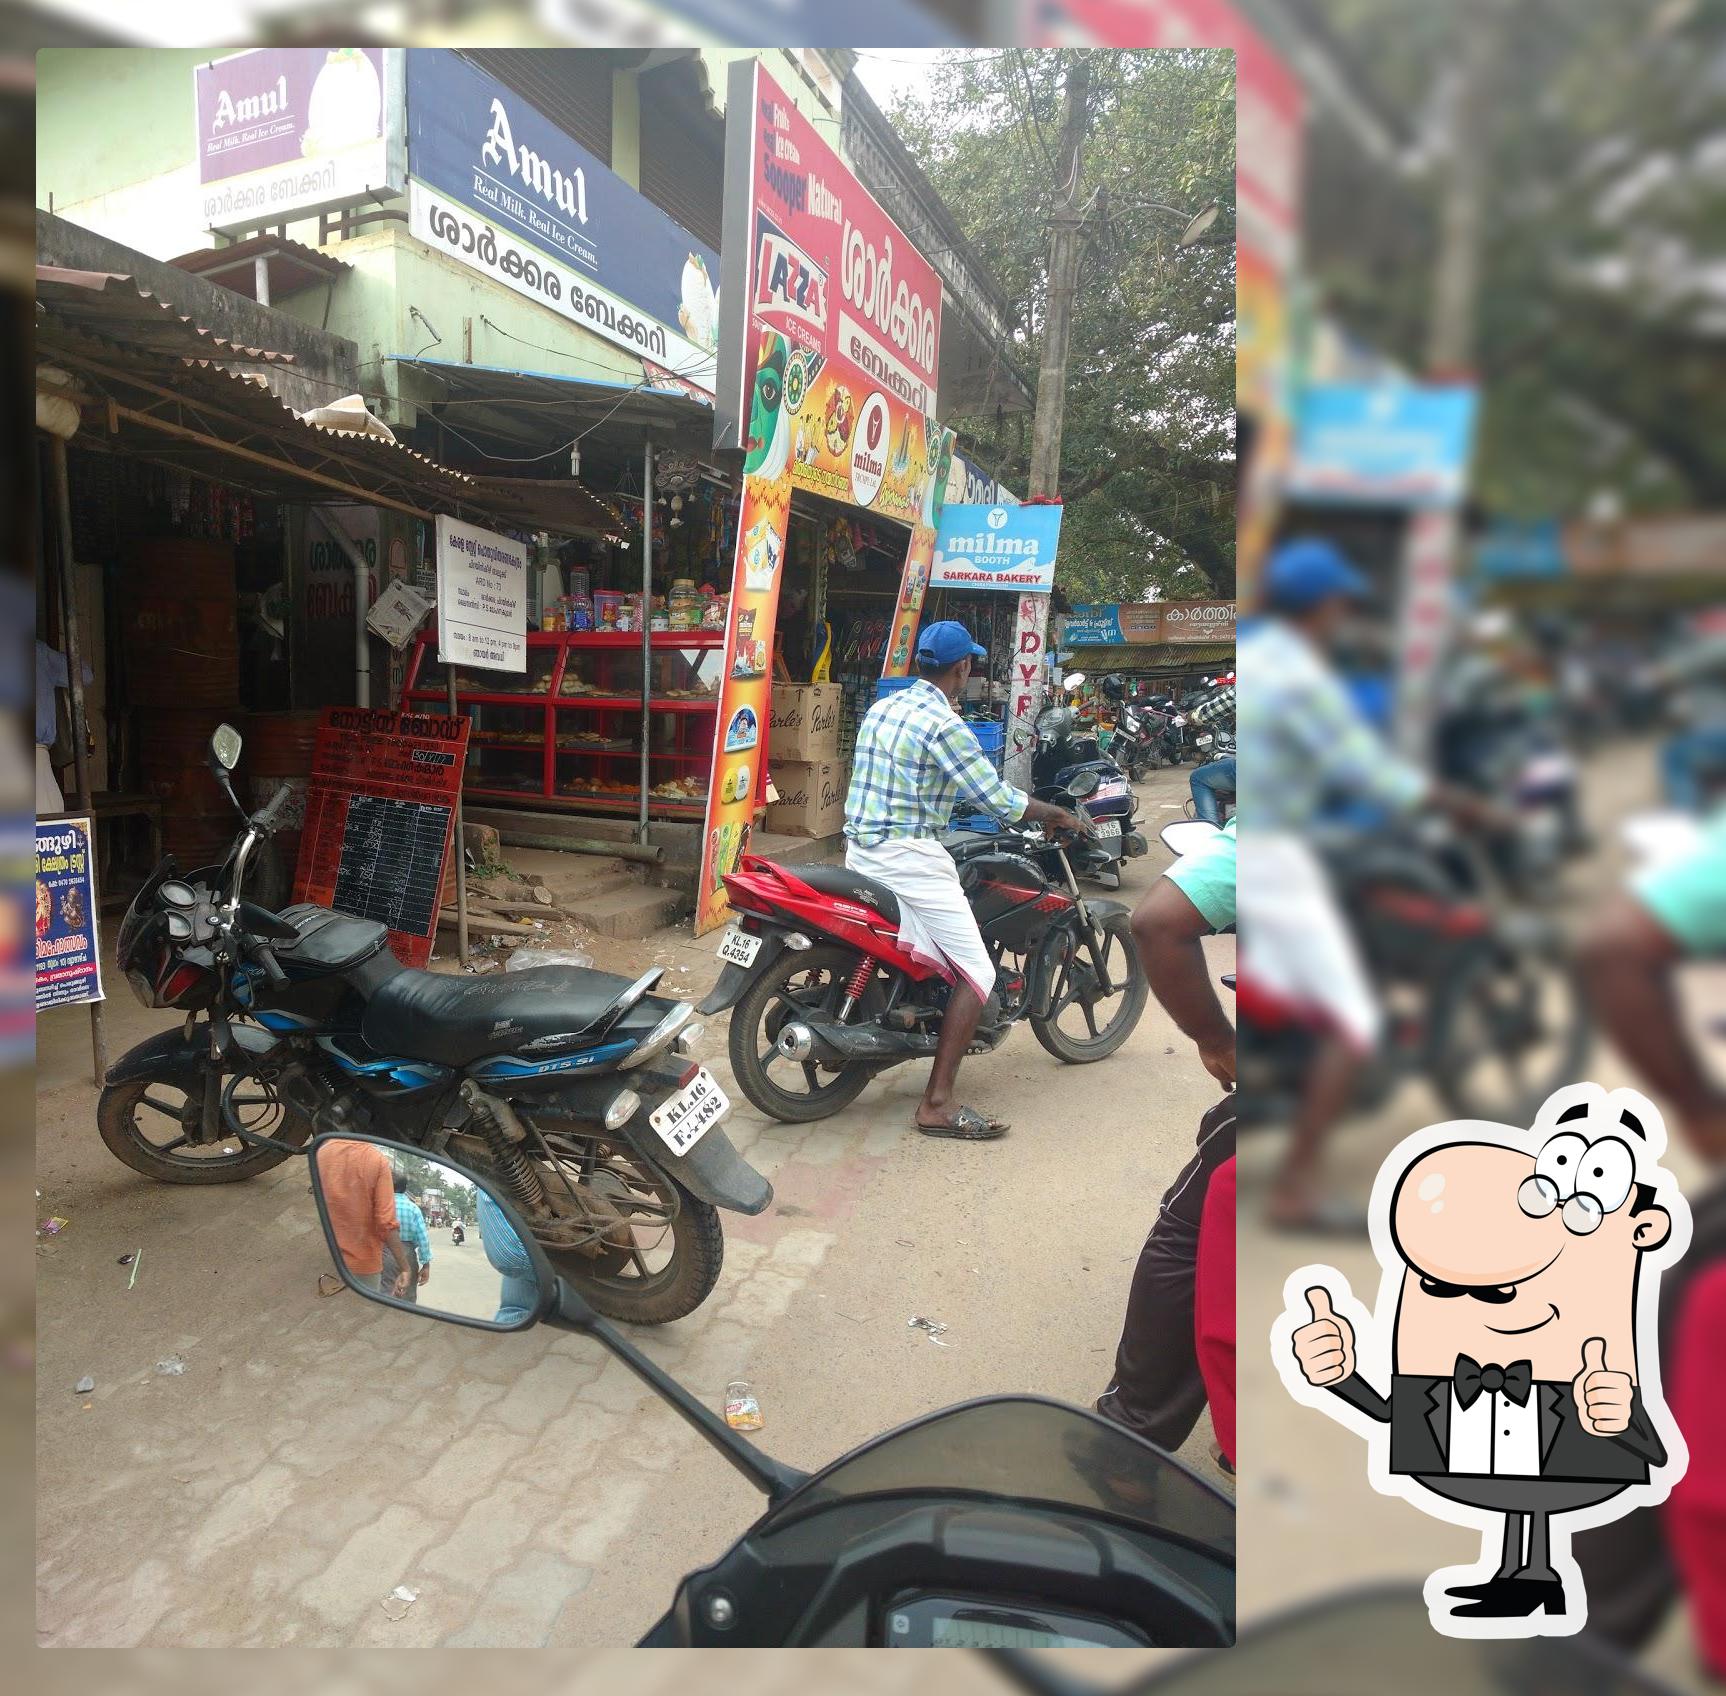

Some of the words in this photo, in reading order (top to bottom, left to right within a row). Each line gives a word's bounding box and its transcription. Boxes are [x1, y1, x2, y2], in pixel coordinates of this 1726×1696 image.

[213, 75, 289, 134] Amul
[271, 160, 336, 203] ബേക്കറി
[482, 98, 588, 224] Amul
[474, 174, 499, 201] Real
[500, 191, 527, 219] Milk.
[529, 210, 551, 234] Real
[552, 224, 566, 243] Ice
[567, 235, 599, 265] Cream.
[808, 173, 843, 225] Natural
[430, 205, 562, 301] ശാർക്കര
[571, 285, 668, 358] ബേക്കറി
[758, 238, 826, 318] LAZZA
[842, 217, 935, 375] ശാർക്കര
[786, 315, 797, 334] ICE
[797, 325, 822, 353] CREAMS
[850, 336, 928, 412] ബേക്കറി
[854, 450, 882, 477] milma
[947, 532, 1039, 556] milma
[974, 556, 1010, 565] BOOTH
[943, 571, 993, 583] SARKARA
[996, 573, 1041, 584] BAKERY
[811, 704, 836, 734] Parle's
[722, 944, 750, 963] Q.4354
[731, 934, 751, 949] KL.16
[667, 1083, 706, 1125] KL.16
